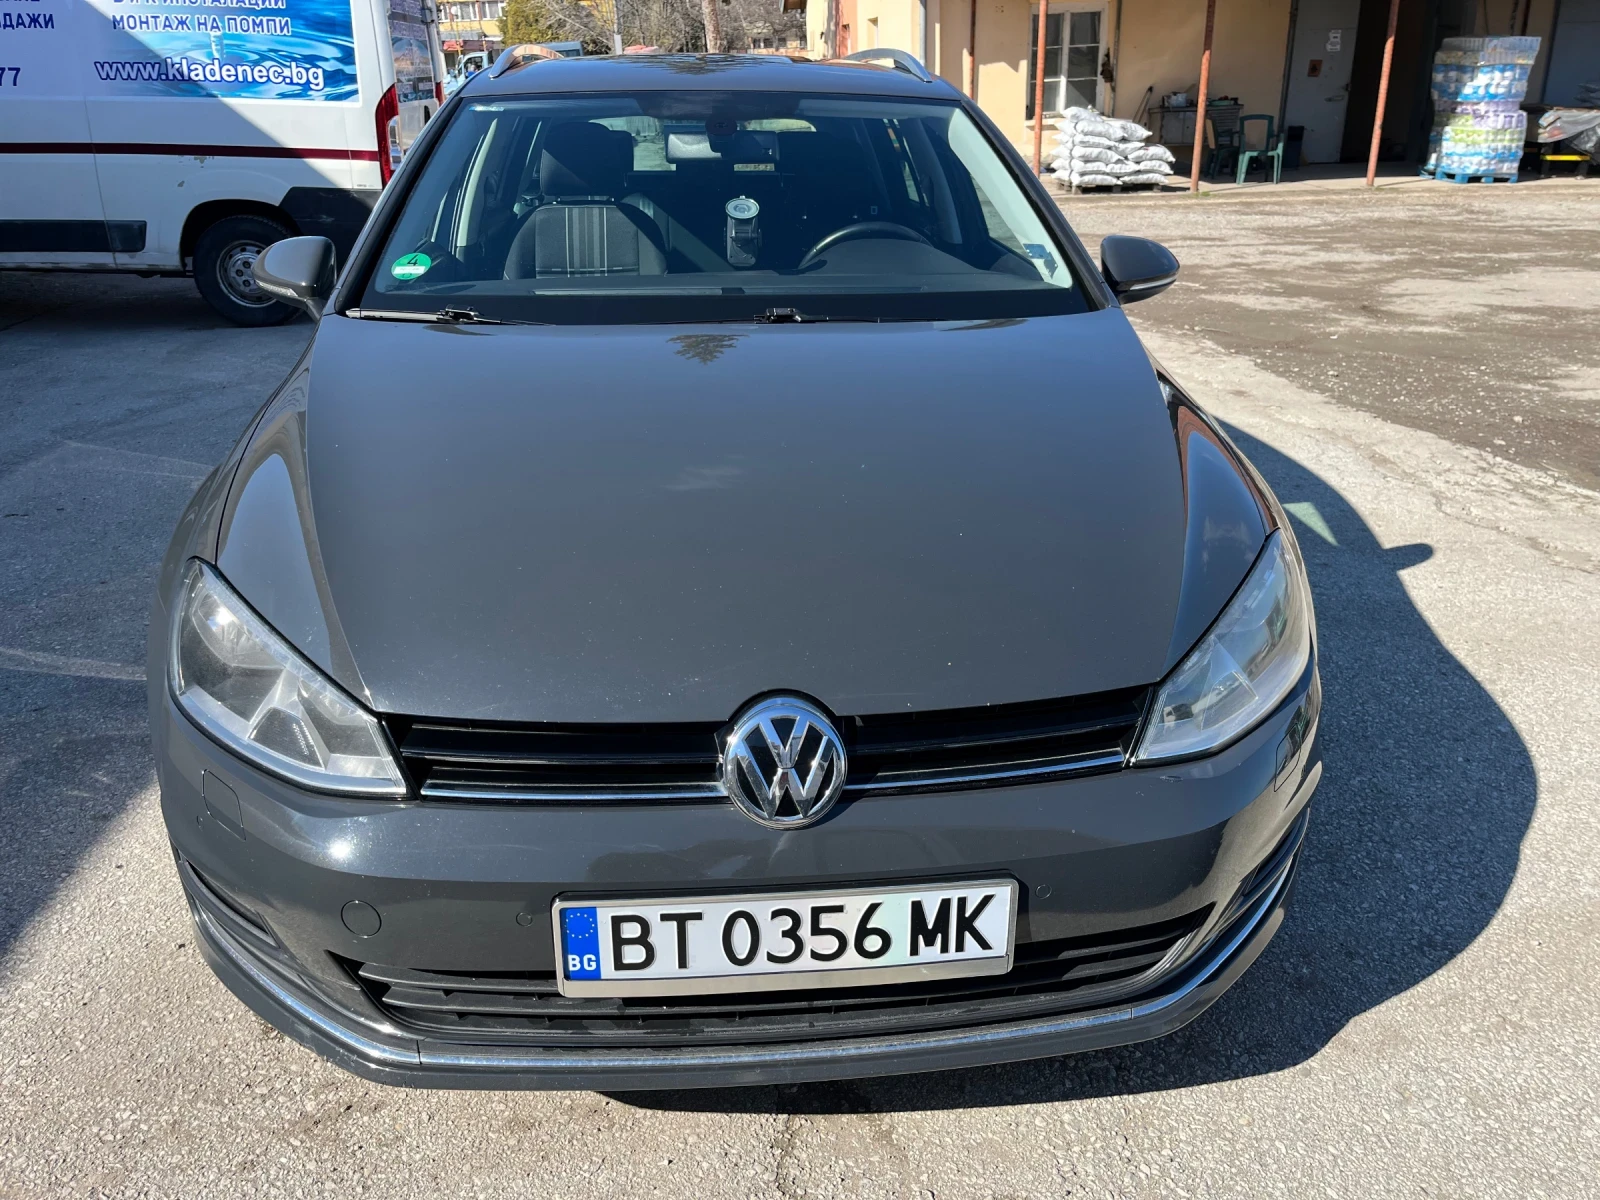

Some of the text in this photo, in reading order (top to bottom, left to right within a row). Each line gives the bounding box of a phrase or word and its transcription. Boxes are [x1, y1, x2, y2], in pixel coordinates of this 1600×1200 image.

[0, 12, 55, 30] ДАЖИ
[111, 14, 292, 35] МОНТАЖ НА ПОМПИ
[94, 57, 325, 90] www.kladenec.bg
[406, 253, 419, 267] 4
[609, 893, 997, 972] BT 0356 MK
[567, 953, 597, 971] BG
